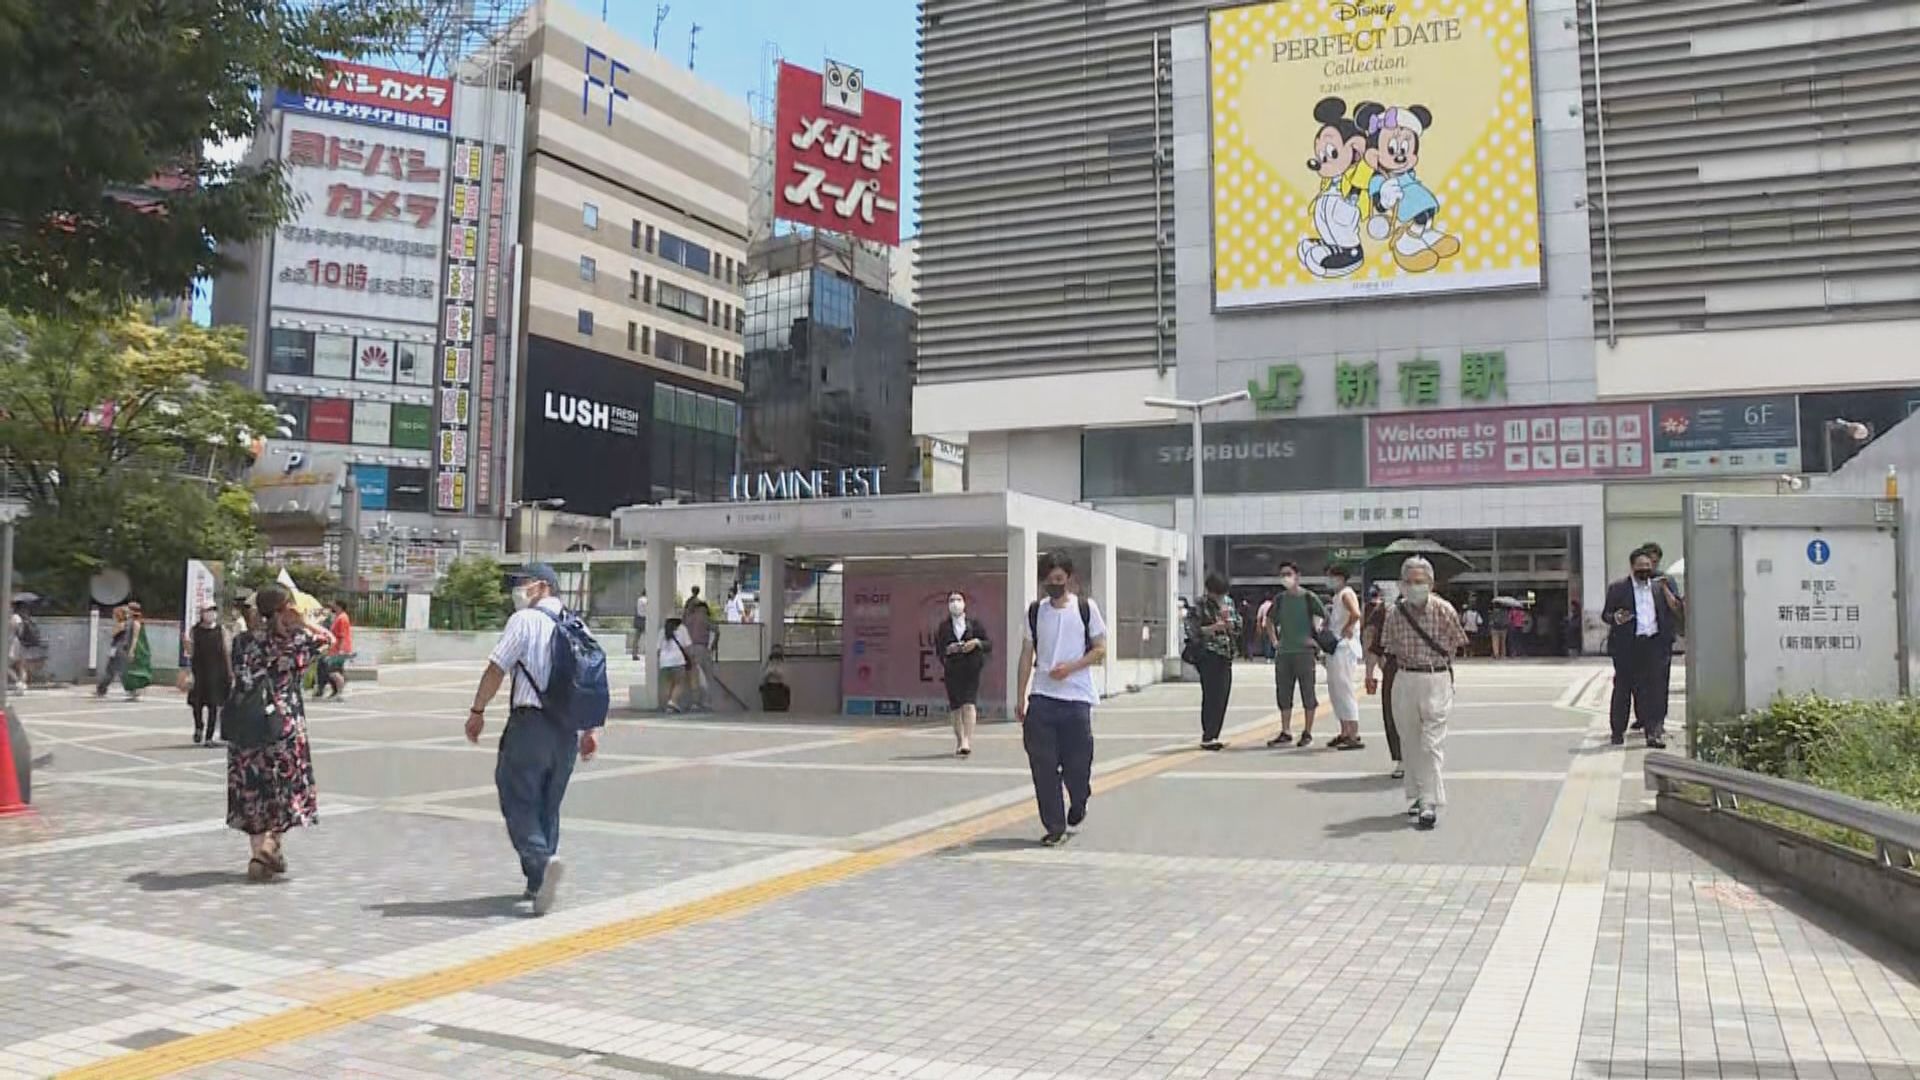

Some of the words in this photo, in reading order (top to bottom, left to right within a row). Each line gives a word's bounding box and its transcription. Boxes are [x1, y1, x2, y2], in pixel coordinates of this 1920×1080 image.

[1271, 27, 1387, 63] PERFECT
[1393, 18, 1462, 48] DATE
[1323, 55, 1406, 77] Collection
[791, 116, 893, 171] メガネ
[784, 161, 897, 224] スーパー
[325, 183, 440, 228] カメラ
[1336, 350, 1509, 408] 新宿駅
[544, 391, 609, 431] LUSH
[611, 405, 639, 421] FRESH
[1744, 404, 1774, 425] 6F
[1376, 423, 1469, 442] Welcome
[1475, 421, 1497, 439] to
[1157, 440, 1296, 464] STARBUCKS
[1376, 444, 1456, 464] LUMINE
[1462, 441, 1497, 460] EST
[730, 469, 832, 501] LUMINE
[836, 464, 886, 498] EST
[1343, 506, 1420, 521] 新宿駅東口
[1801, 579, 1837, 592] 新宿区
[1778, 605, 1860, 622] 新宿三丁目
